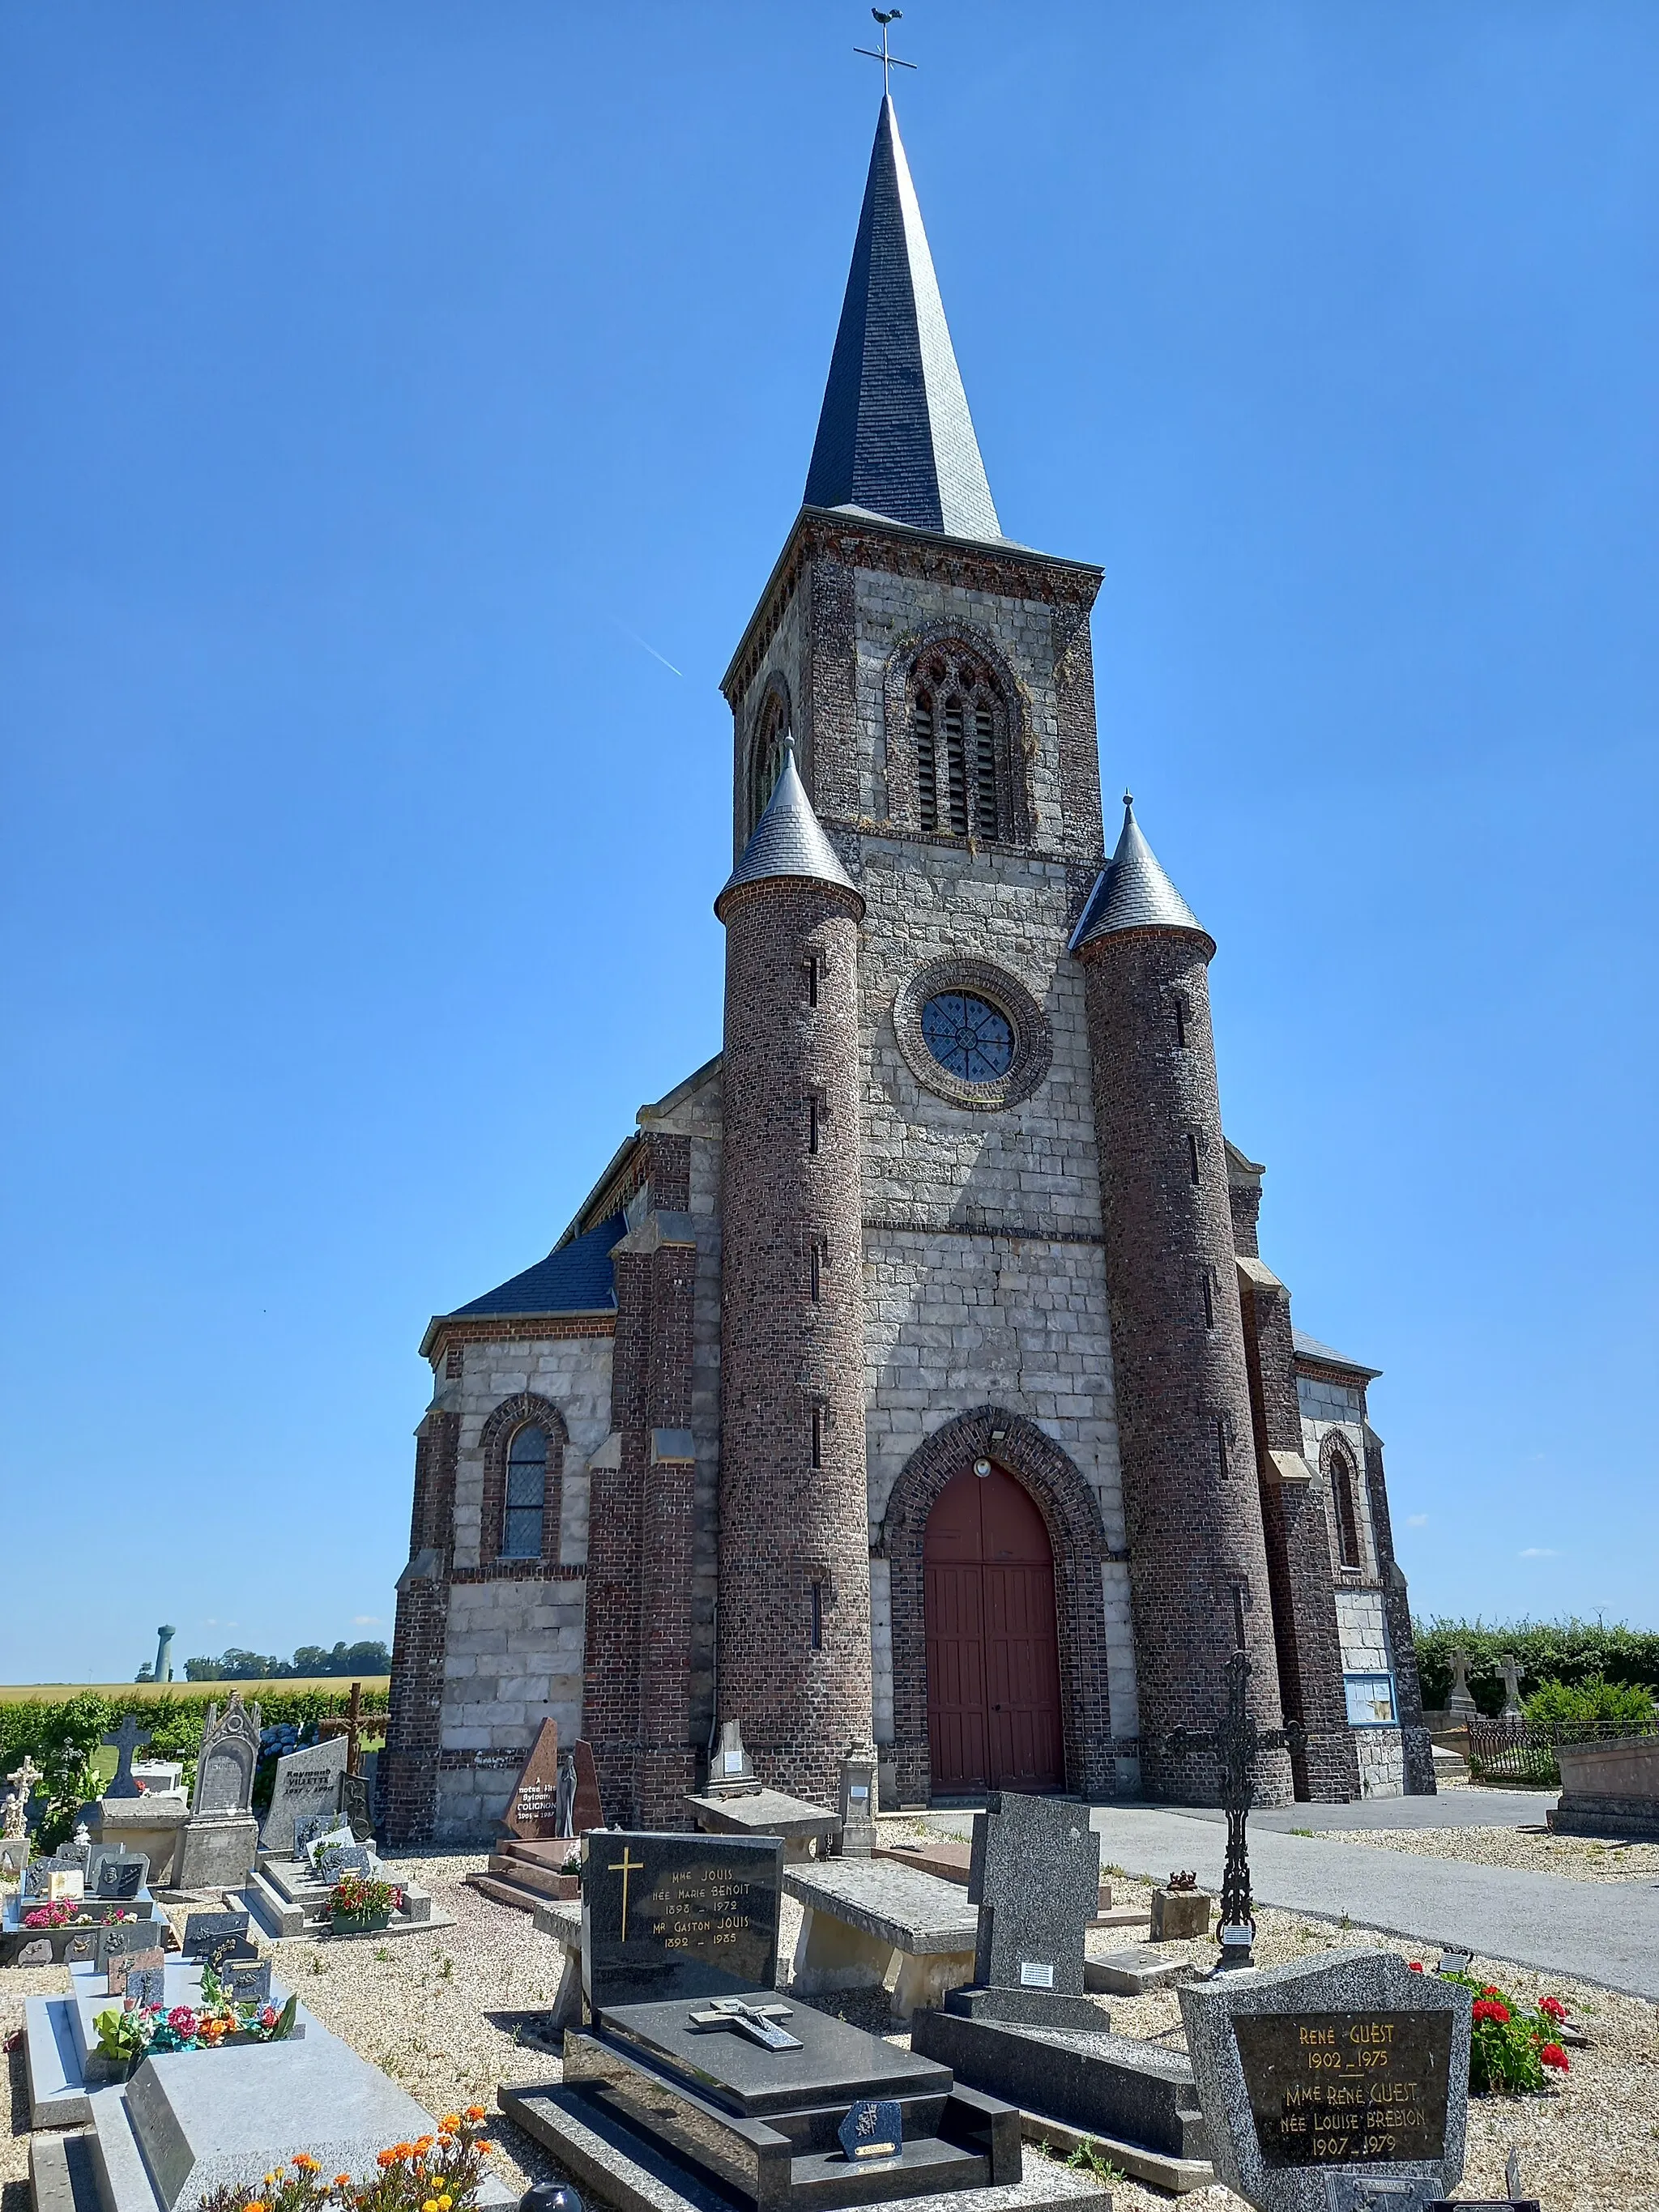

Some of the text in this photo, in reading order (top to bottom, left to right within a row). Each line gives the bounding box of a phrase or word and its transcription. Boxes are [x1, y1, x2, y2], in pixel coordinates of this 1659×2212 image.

[287, 1769, 331, 1778] Raymond
[289, 1777, 329, 1786] VILLETTE
[517, 1802, 557, 1811] COLIGNON
[701, 1869, 733, 1882] JOUIS
[711, 1883, 750, 1897] BENOIT
[666, 1903, 690, 1915] 1898
[714, 1900, 737, 1912] 1972
[717, 1916, 749, 1929] JOUIS
[665, 1937, 689, 1948] 1892
[713, 1933, 736, 1945] 1985
[1349, 2024, 1394, 2044] GUEST
[1308, 2052, 1341, 2069] 1902
[1358, 2050, 1388, 2066] 1975
[1370, 2082, 1418, 2103] GUEST
[1313, 2137, 1349, 2156] 1907
[1365, 2135, 1396, 2154] 1979
